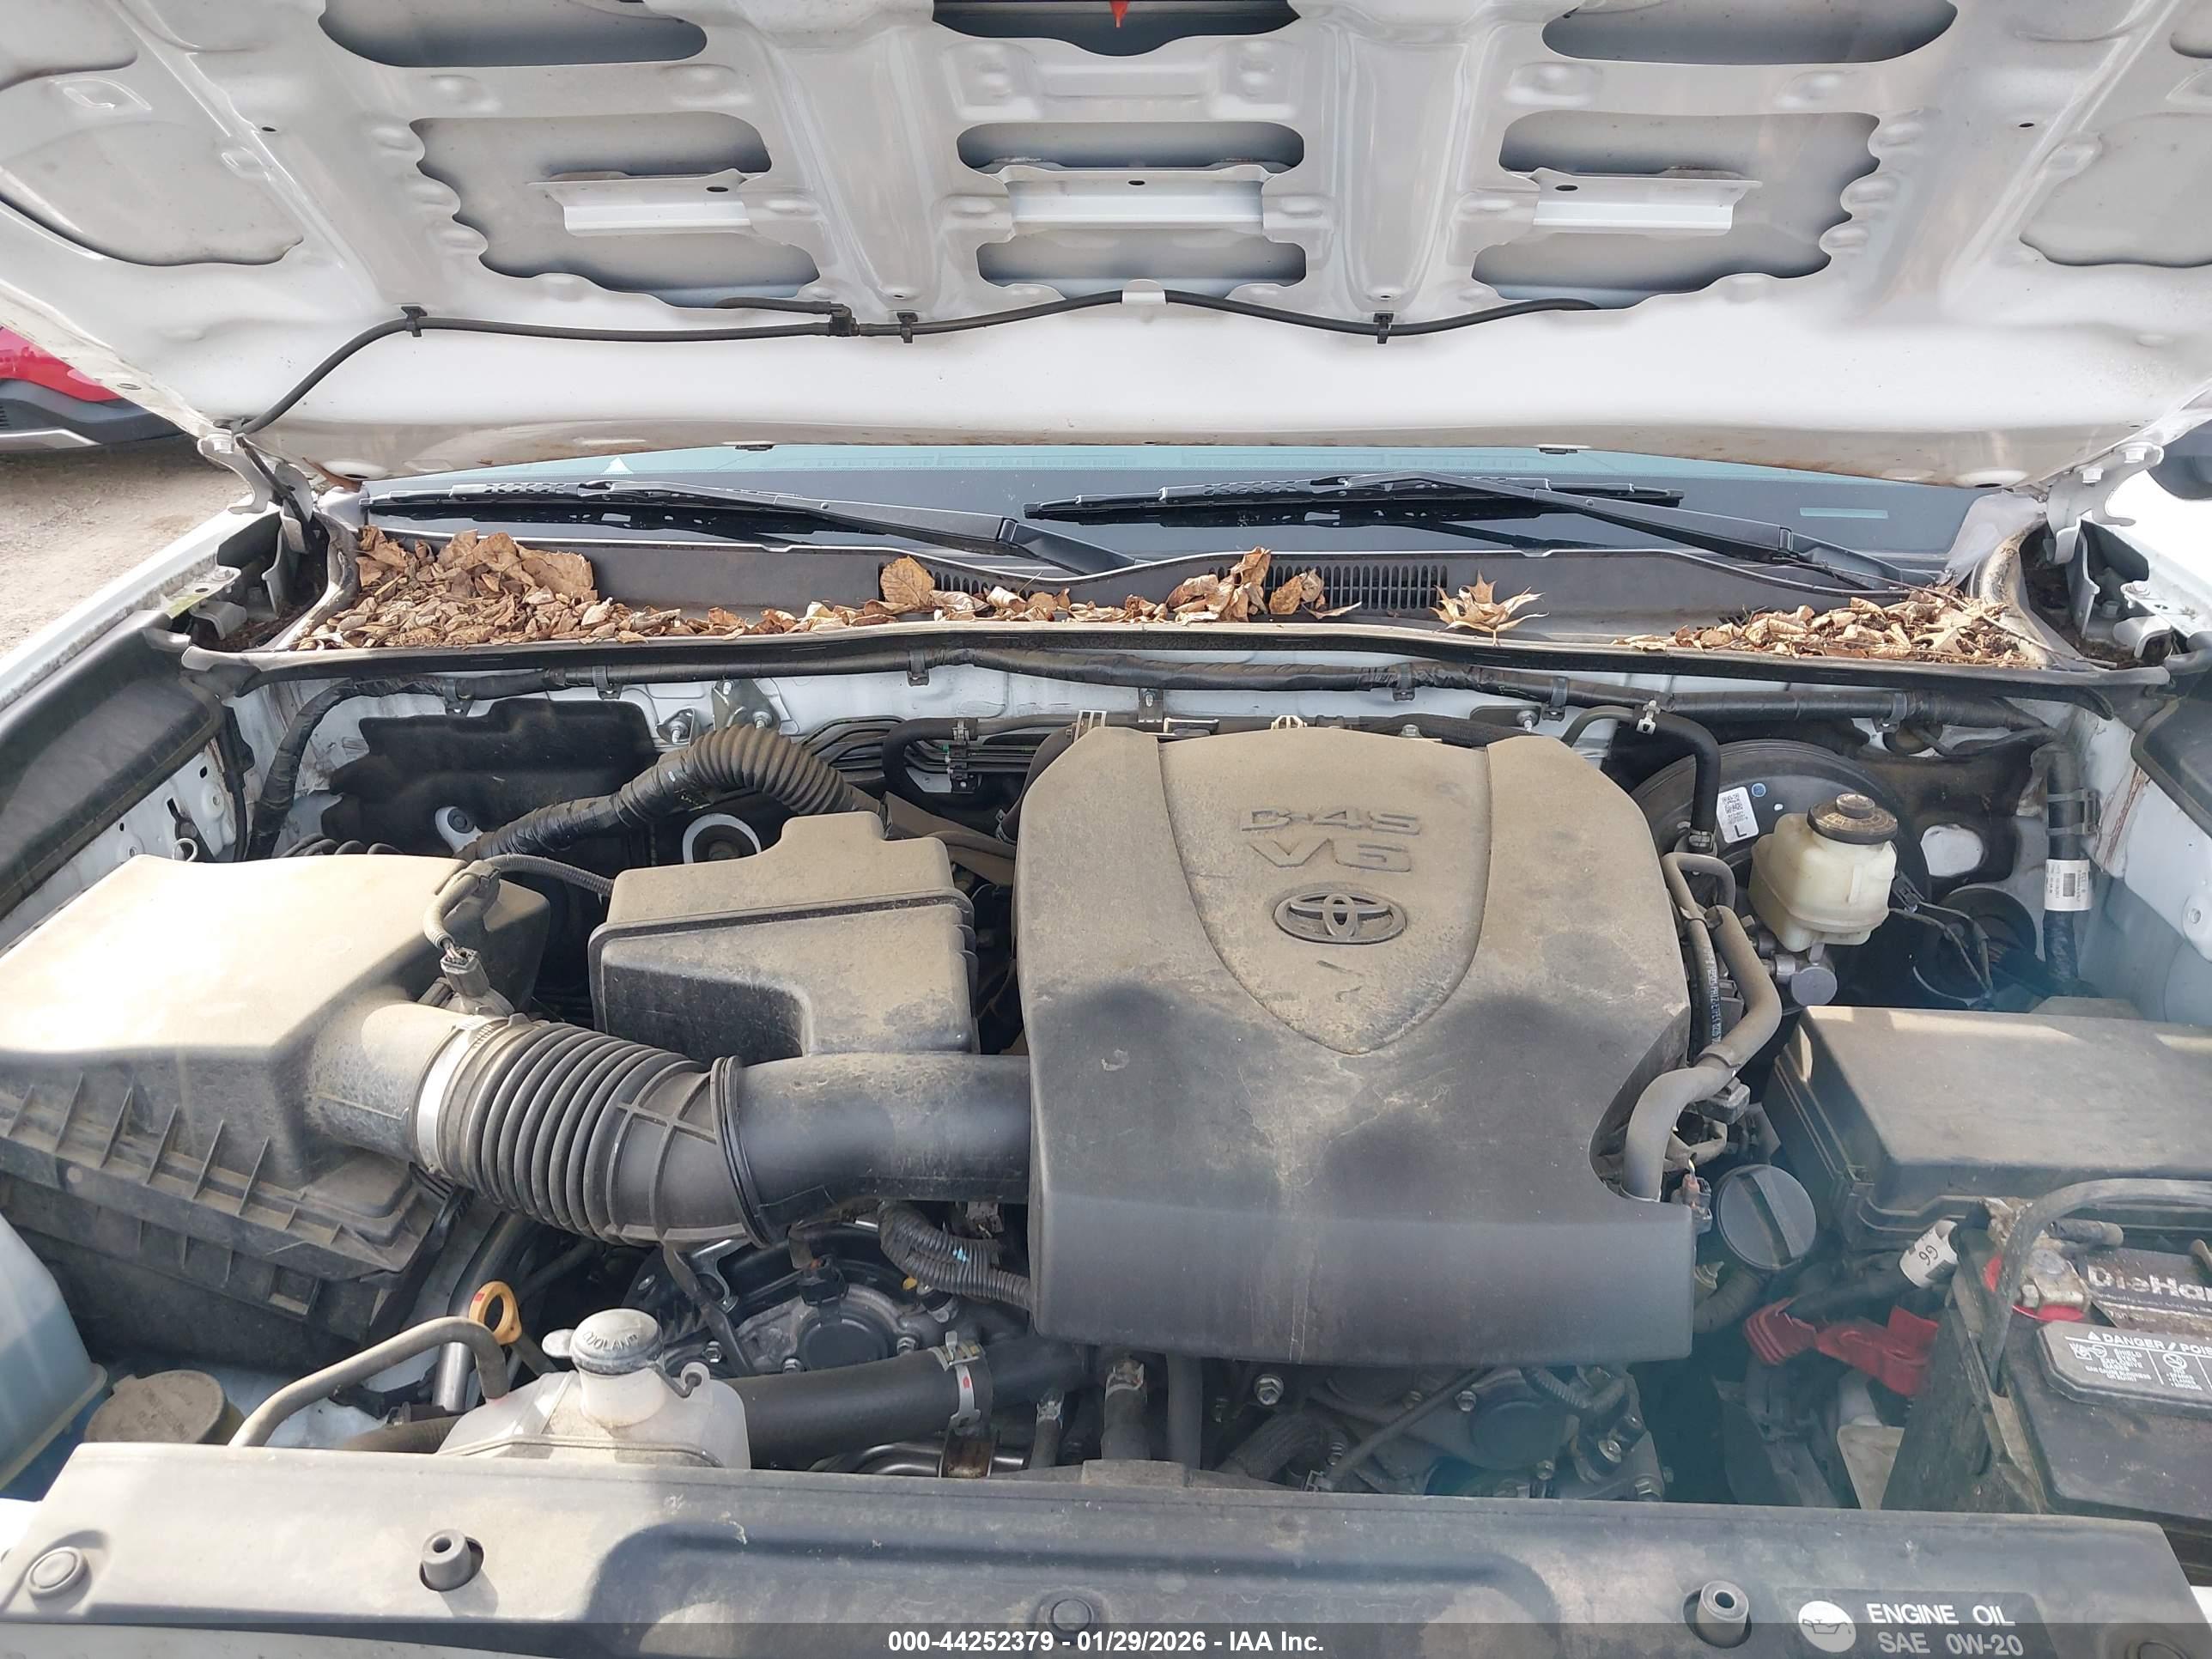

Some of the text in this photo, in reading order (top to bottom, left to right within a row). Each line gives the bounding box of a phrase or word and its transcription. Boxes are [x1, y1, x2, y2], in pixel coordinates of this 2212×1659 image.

[1242, 810, 1420, 835] D-4S
[1735, 824, 1747, 838] L
[1246, 838, 1412, 873] V6
[2101, 1334, 2165, 1350] DANGER
[1866, 1603, 2016, 1626] ENGINE OIL
[1877, 1632, 2024, 1656] SAE 0W-20
